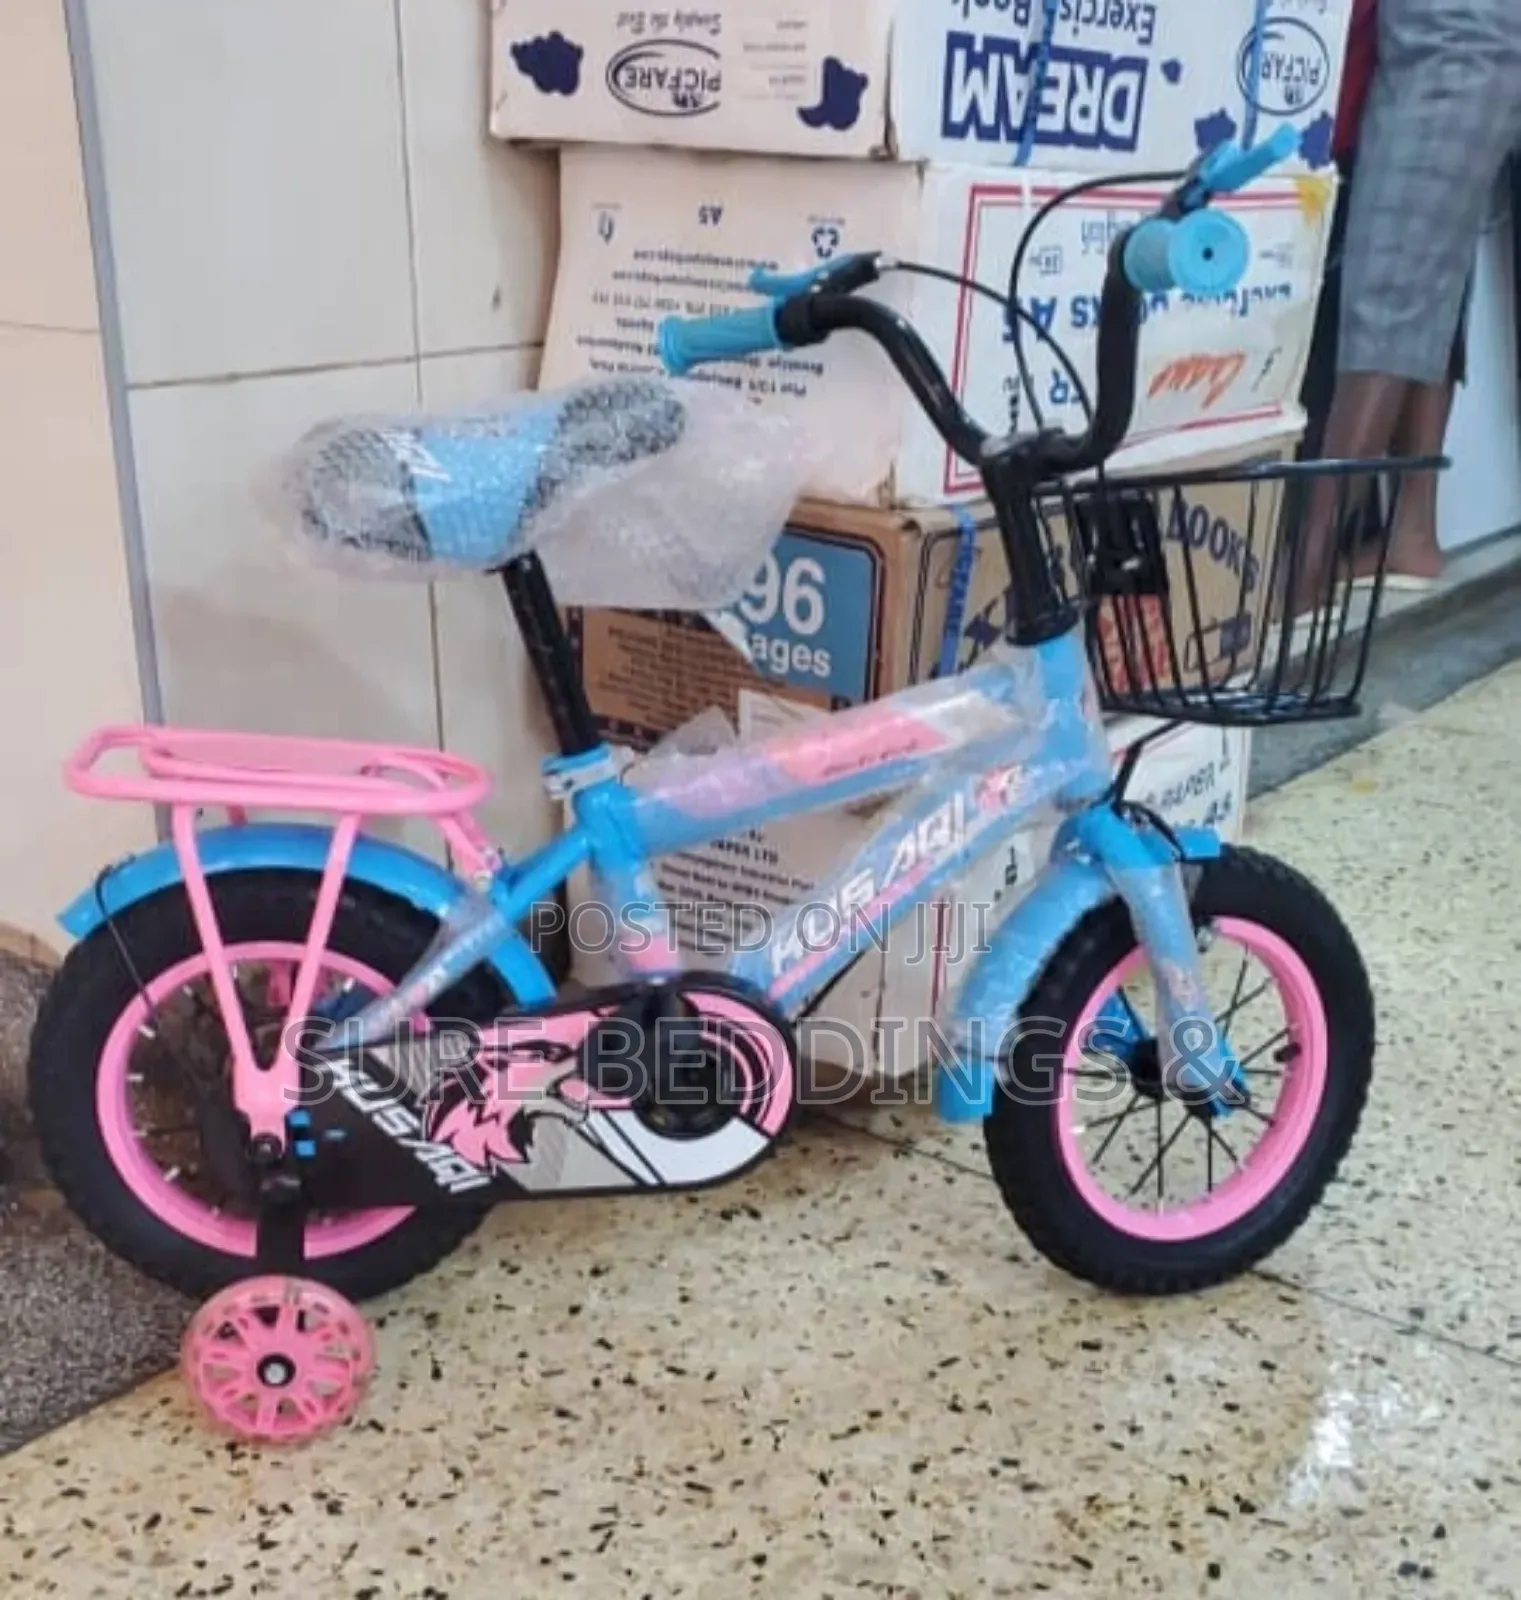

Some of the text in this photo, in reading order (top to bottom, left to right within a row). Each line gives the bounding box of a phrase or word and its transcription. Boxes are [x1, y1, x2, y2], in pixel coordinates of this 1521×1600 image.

[1048, 2, 1157, 46] Exercis
[624, 64, 722, 92] PICFARE
[1254, 49, 1323, 86] PICFAR
[948, 44, 1143, 144] DREAM
[738, 549, 826, 635] 96
[750, 633, 833, 678] ages
